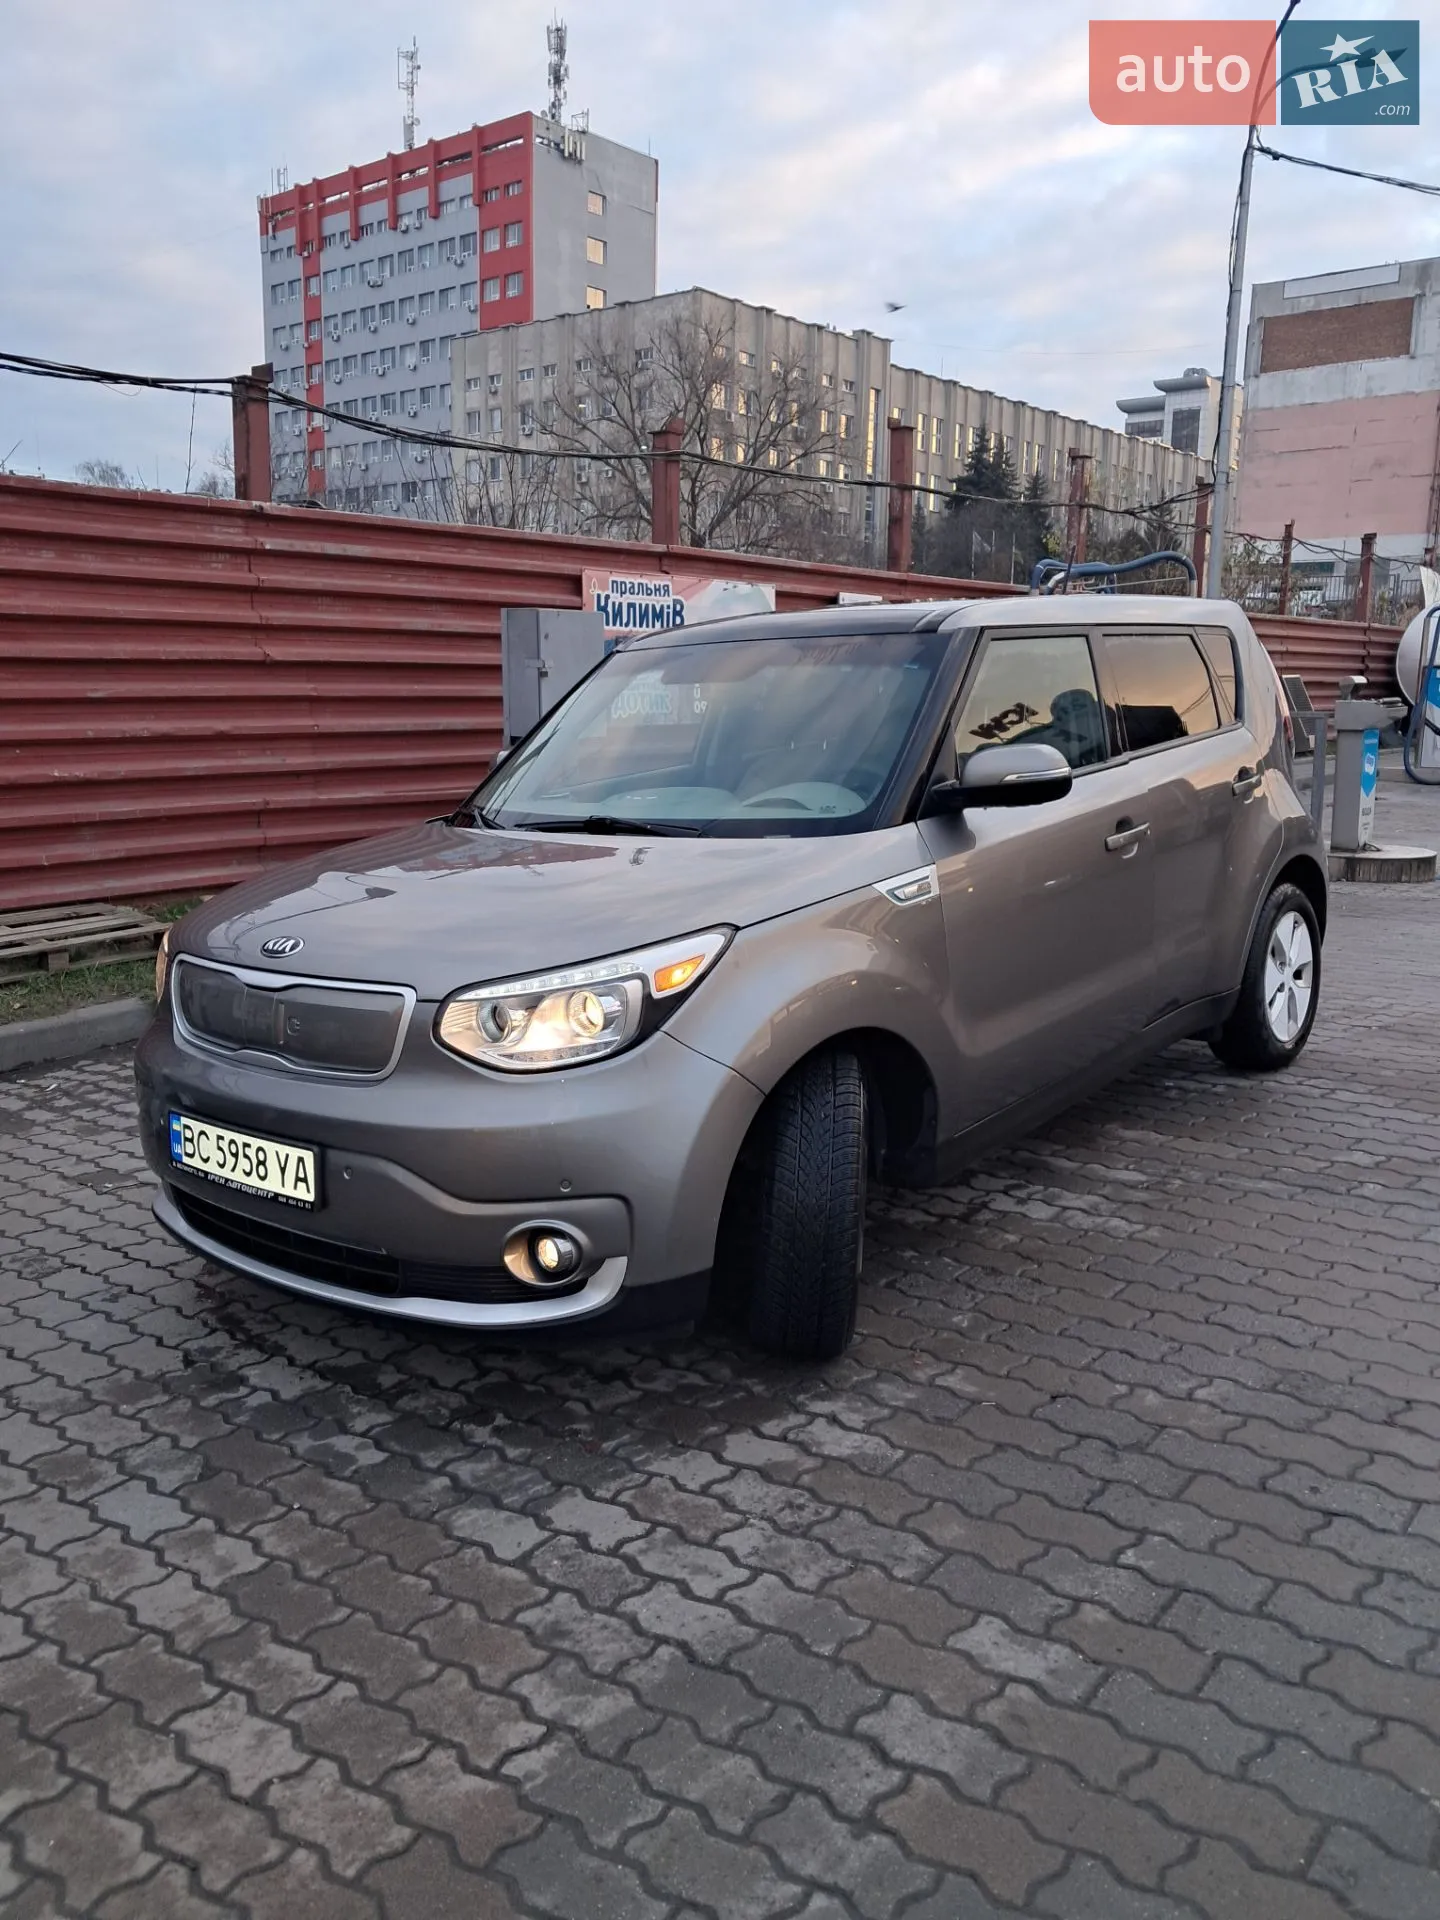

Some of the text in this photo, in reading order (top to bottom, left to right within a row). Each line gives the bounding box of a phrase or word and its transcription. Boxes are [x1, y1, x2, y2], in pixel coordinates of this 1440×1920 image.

[611, 578, 670, 598] пральня
[263, 937, 296, 953] KIA
[173, 1142, 182, 1154] UA
[182, 1123, 211, 1164] BC
[216, 1134, 268, 1182] 5958
[276, 1150, 311, 1194] YA
